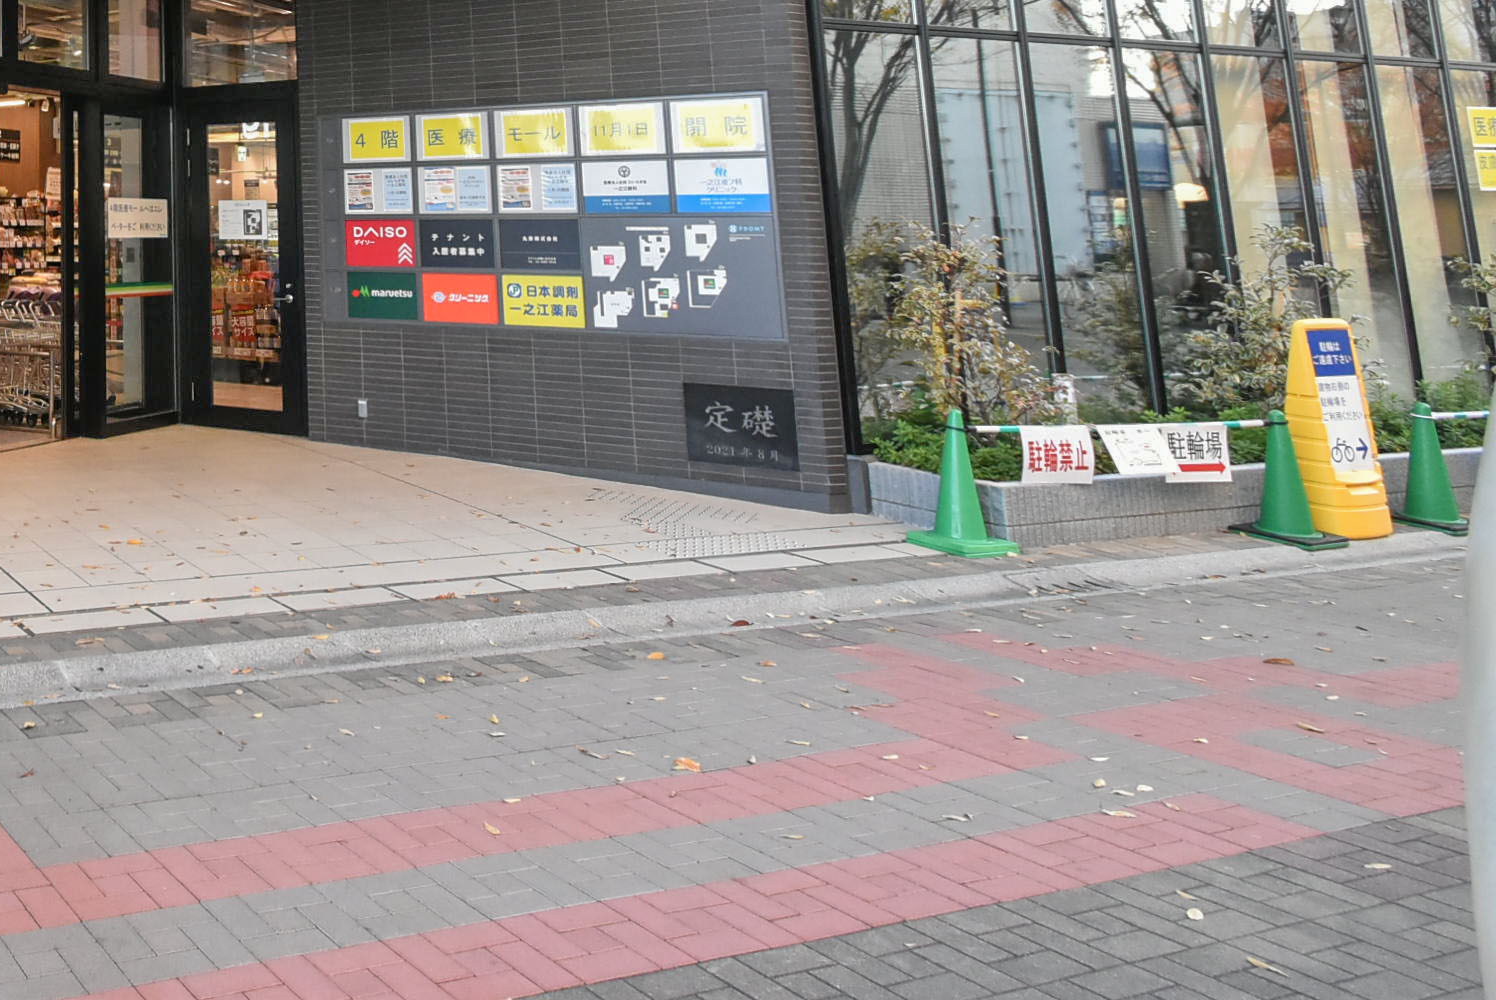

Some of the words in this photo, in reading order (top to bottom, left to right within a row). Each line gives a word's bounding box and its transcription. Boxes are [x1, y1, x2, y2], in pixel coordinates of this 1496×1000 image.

[427, 128, 477, 146] 医療
[507, 126, 562, 141] モール
[594, 121, 648, 137] 11月1日
[353, 226, 407, 238] DAISO
[431, 233, 485, 242] テナント
[371, 288, 413, 298] maruetsu
[449, 292, 489, 303] クリーニング
[526, 285, 579, 299] 日本調剤
[509, 303, 578, 318] 一之江薬局
[1318, 341, 1342, 352] 駐輪は
[705, 401, 779, 438] 定礎
[1167, 431, 1223, 460] 駐輪場
[1028, 440, 1090, 473] 駐輪禁止
